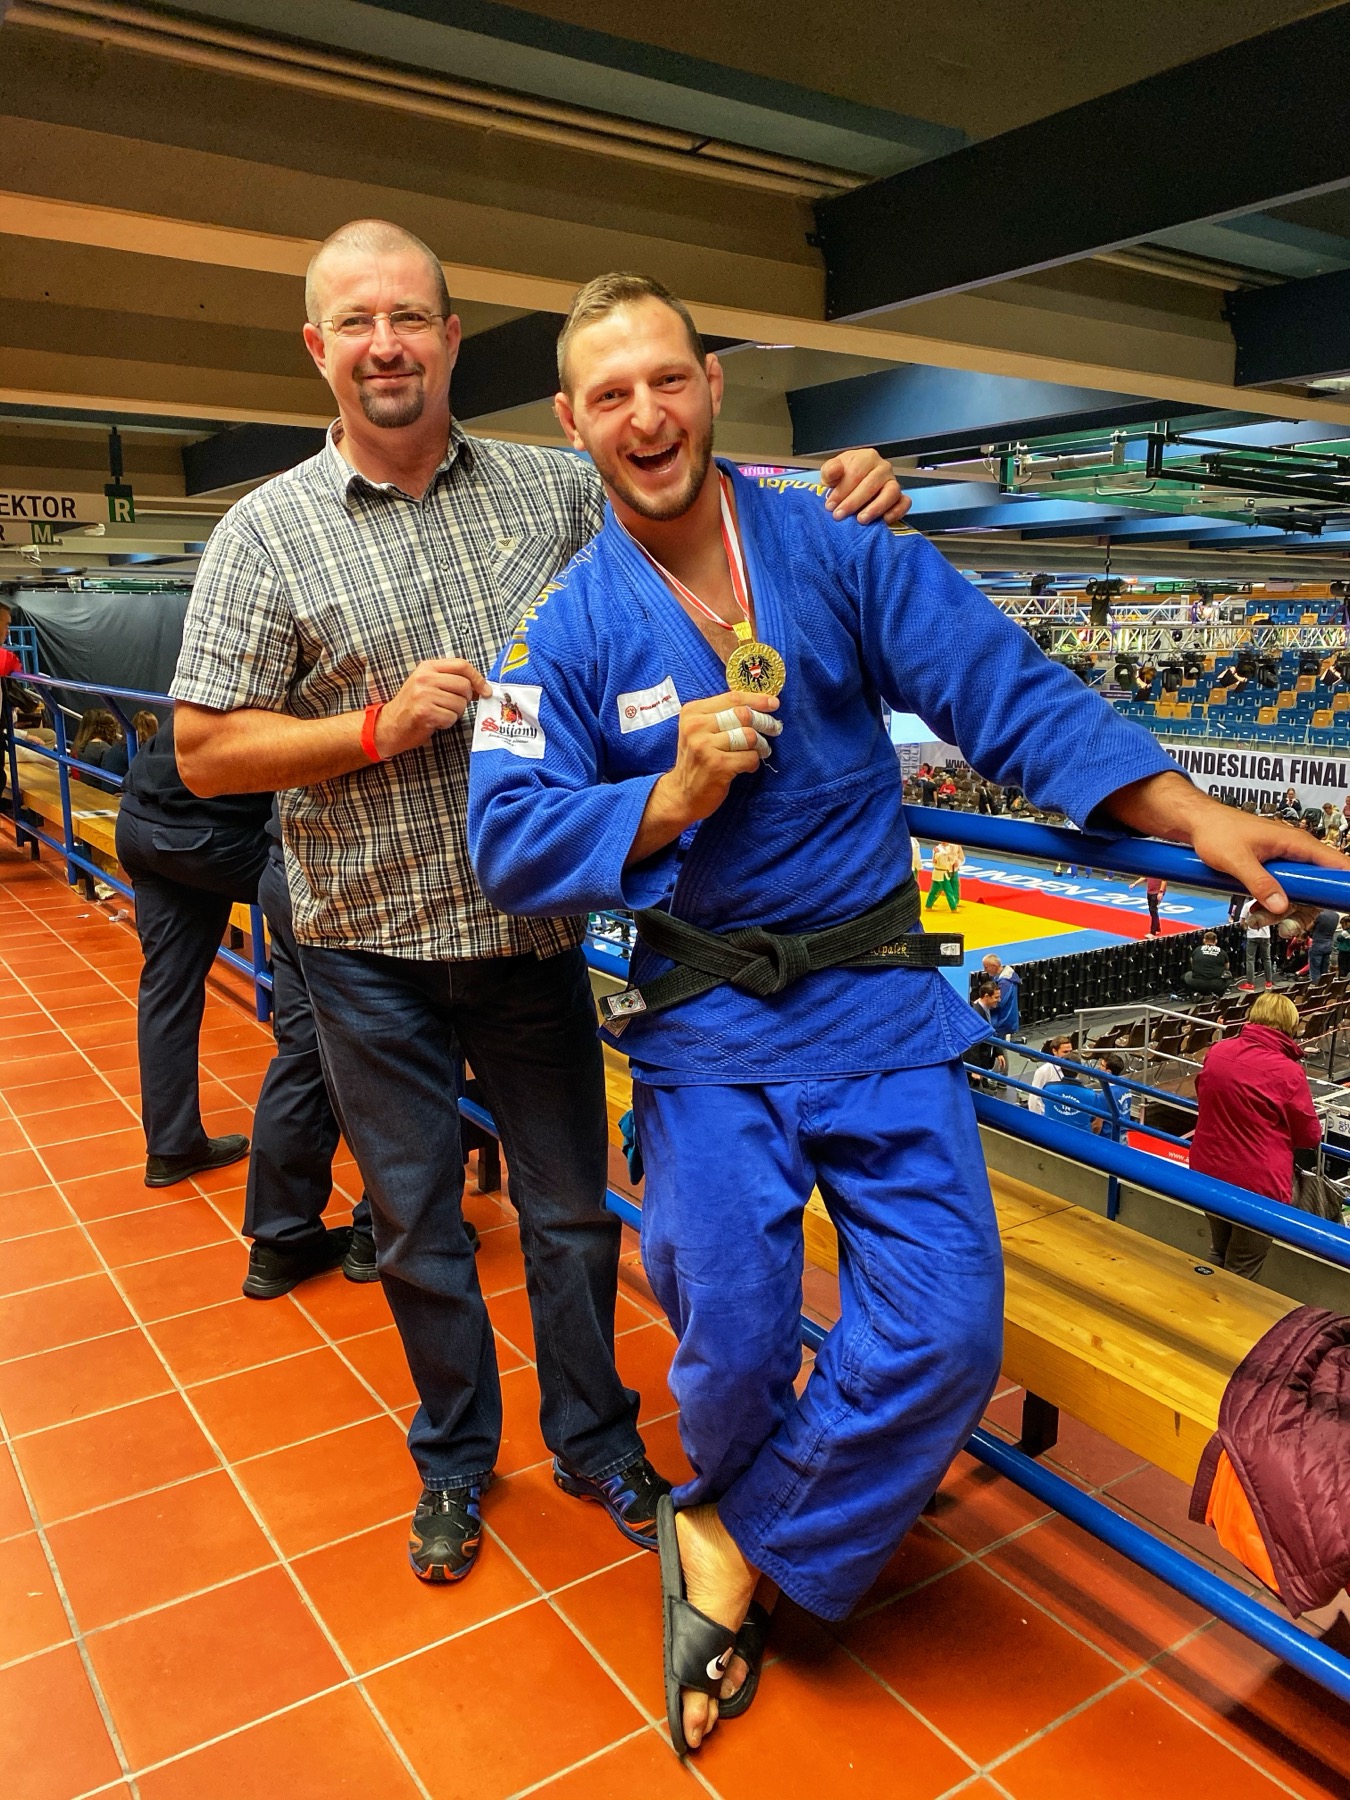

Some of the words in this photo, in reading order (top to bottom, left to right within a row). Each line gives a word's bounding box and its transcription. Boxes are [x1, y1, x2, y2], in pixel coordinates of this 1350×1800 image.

[115, 498, 131, 522] R
[33, 524, 52, 543] M
[1289, 759, 1349, 789] FINAL
[1208, 784, 1287, 808] GMUNDE
[921, 858, 1099, 896] GUNDEN
